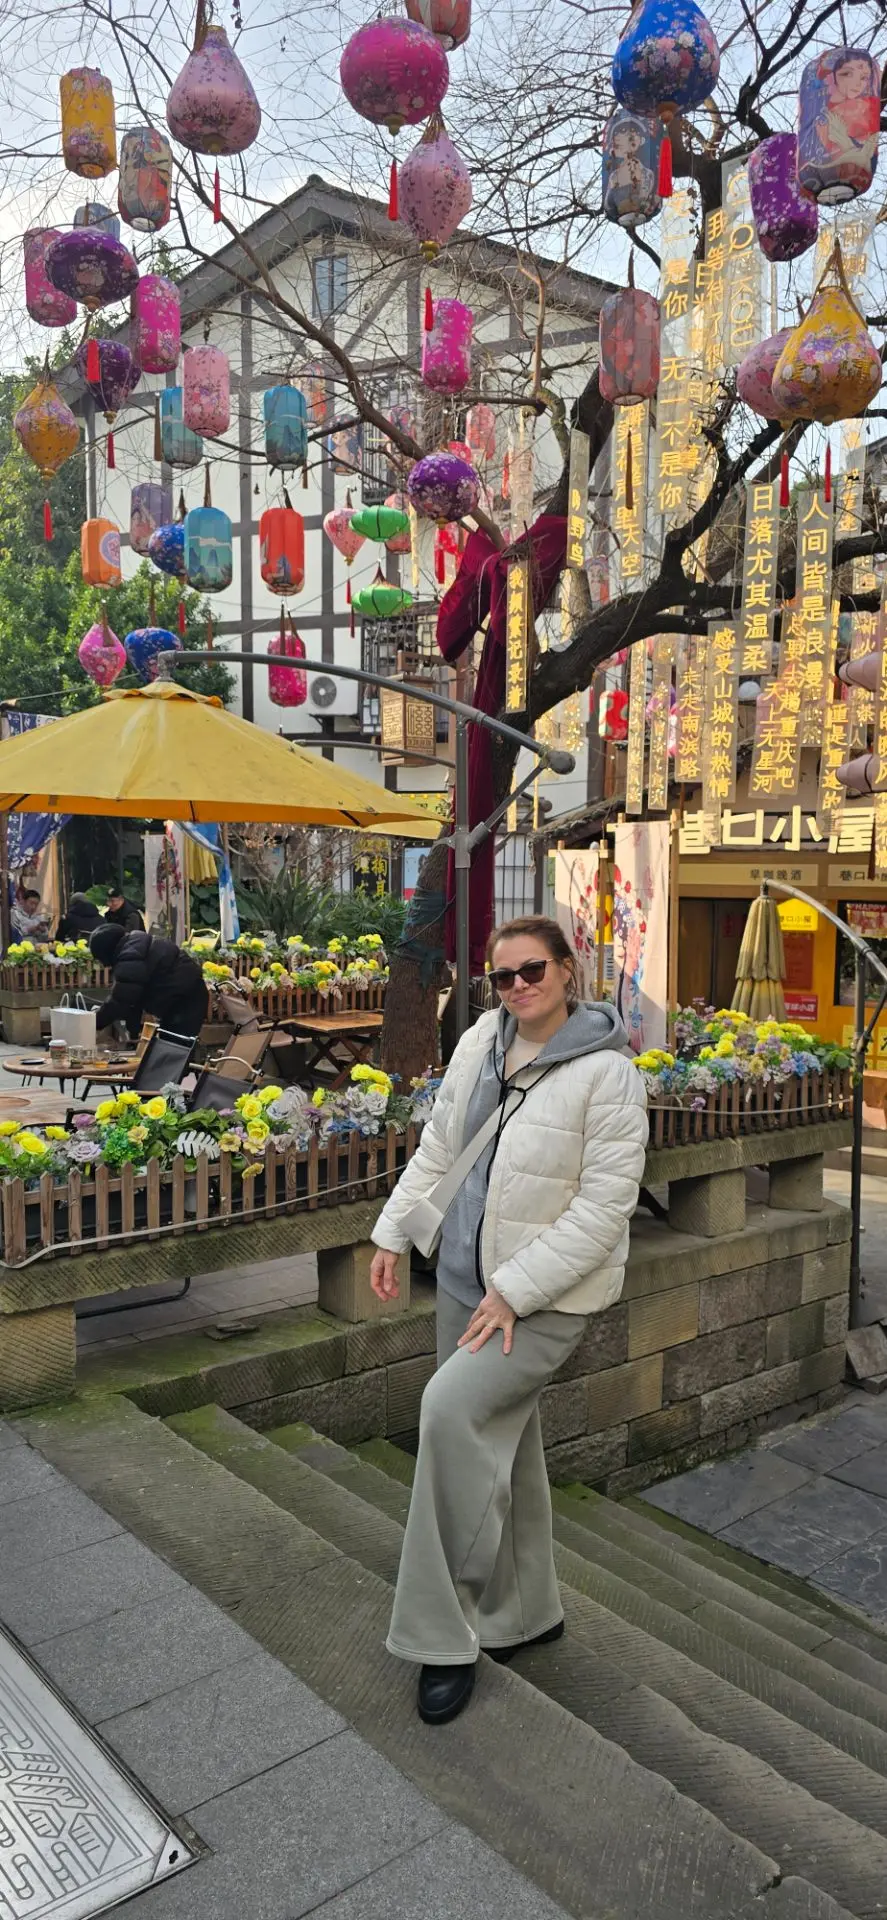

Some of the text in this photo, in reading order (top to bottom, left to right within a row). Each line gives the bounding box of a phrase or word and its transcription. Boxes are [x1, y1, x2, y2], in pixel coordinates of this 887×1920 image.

[742, 486, 774, 671] 日落尤其温柔
[798, 493, 829, 688] 人间皆是浪漫
[678, 667, 701, 778] 走走南滨路
[709, 628, 736, 798] 感受山城的热情
[752, 681, 784, 793] 天上无星河
[776, 614, 804, 788] 总要去趟重庆吧
[679, 805, 875, 854] 巷口小屋
